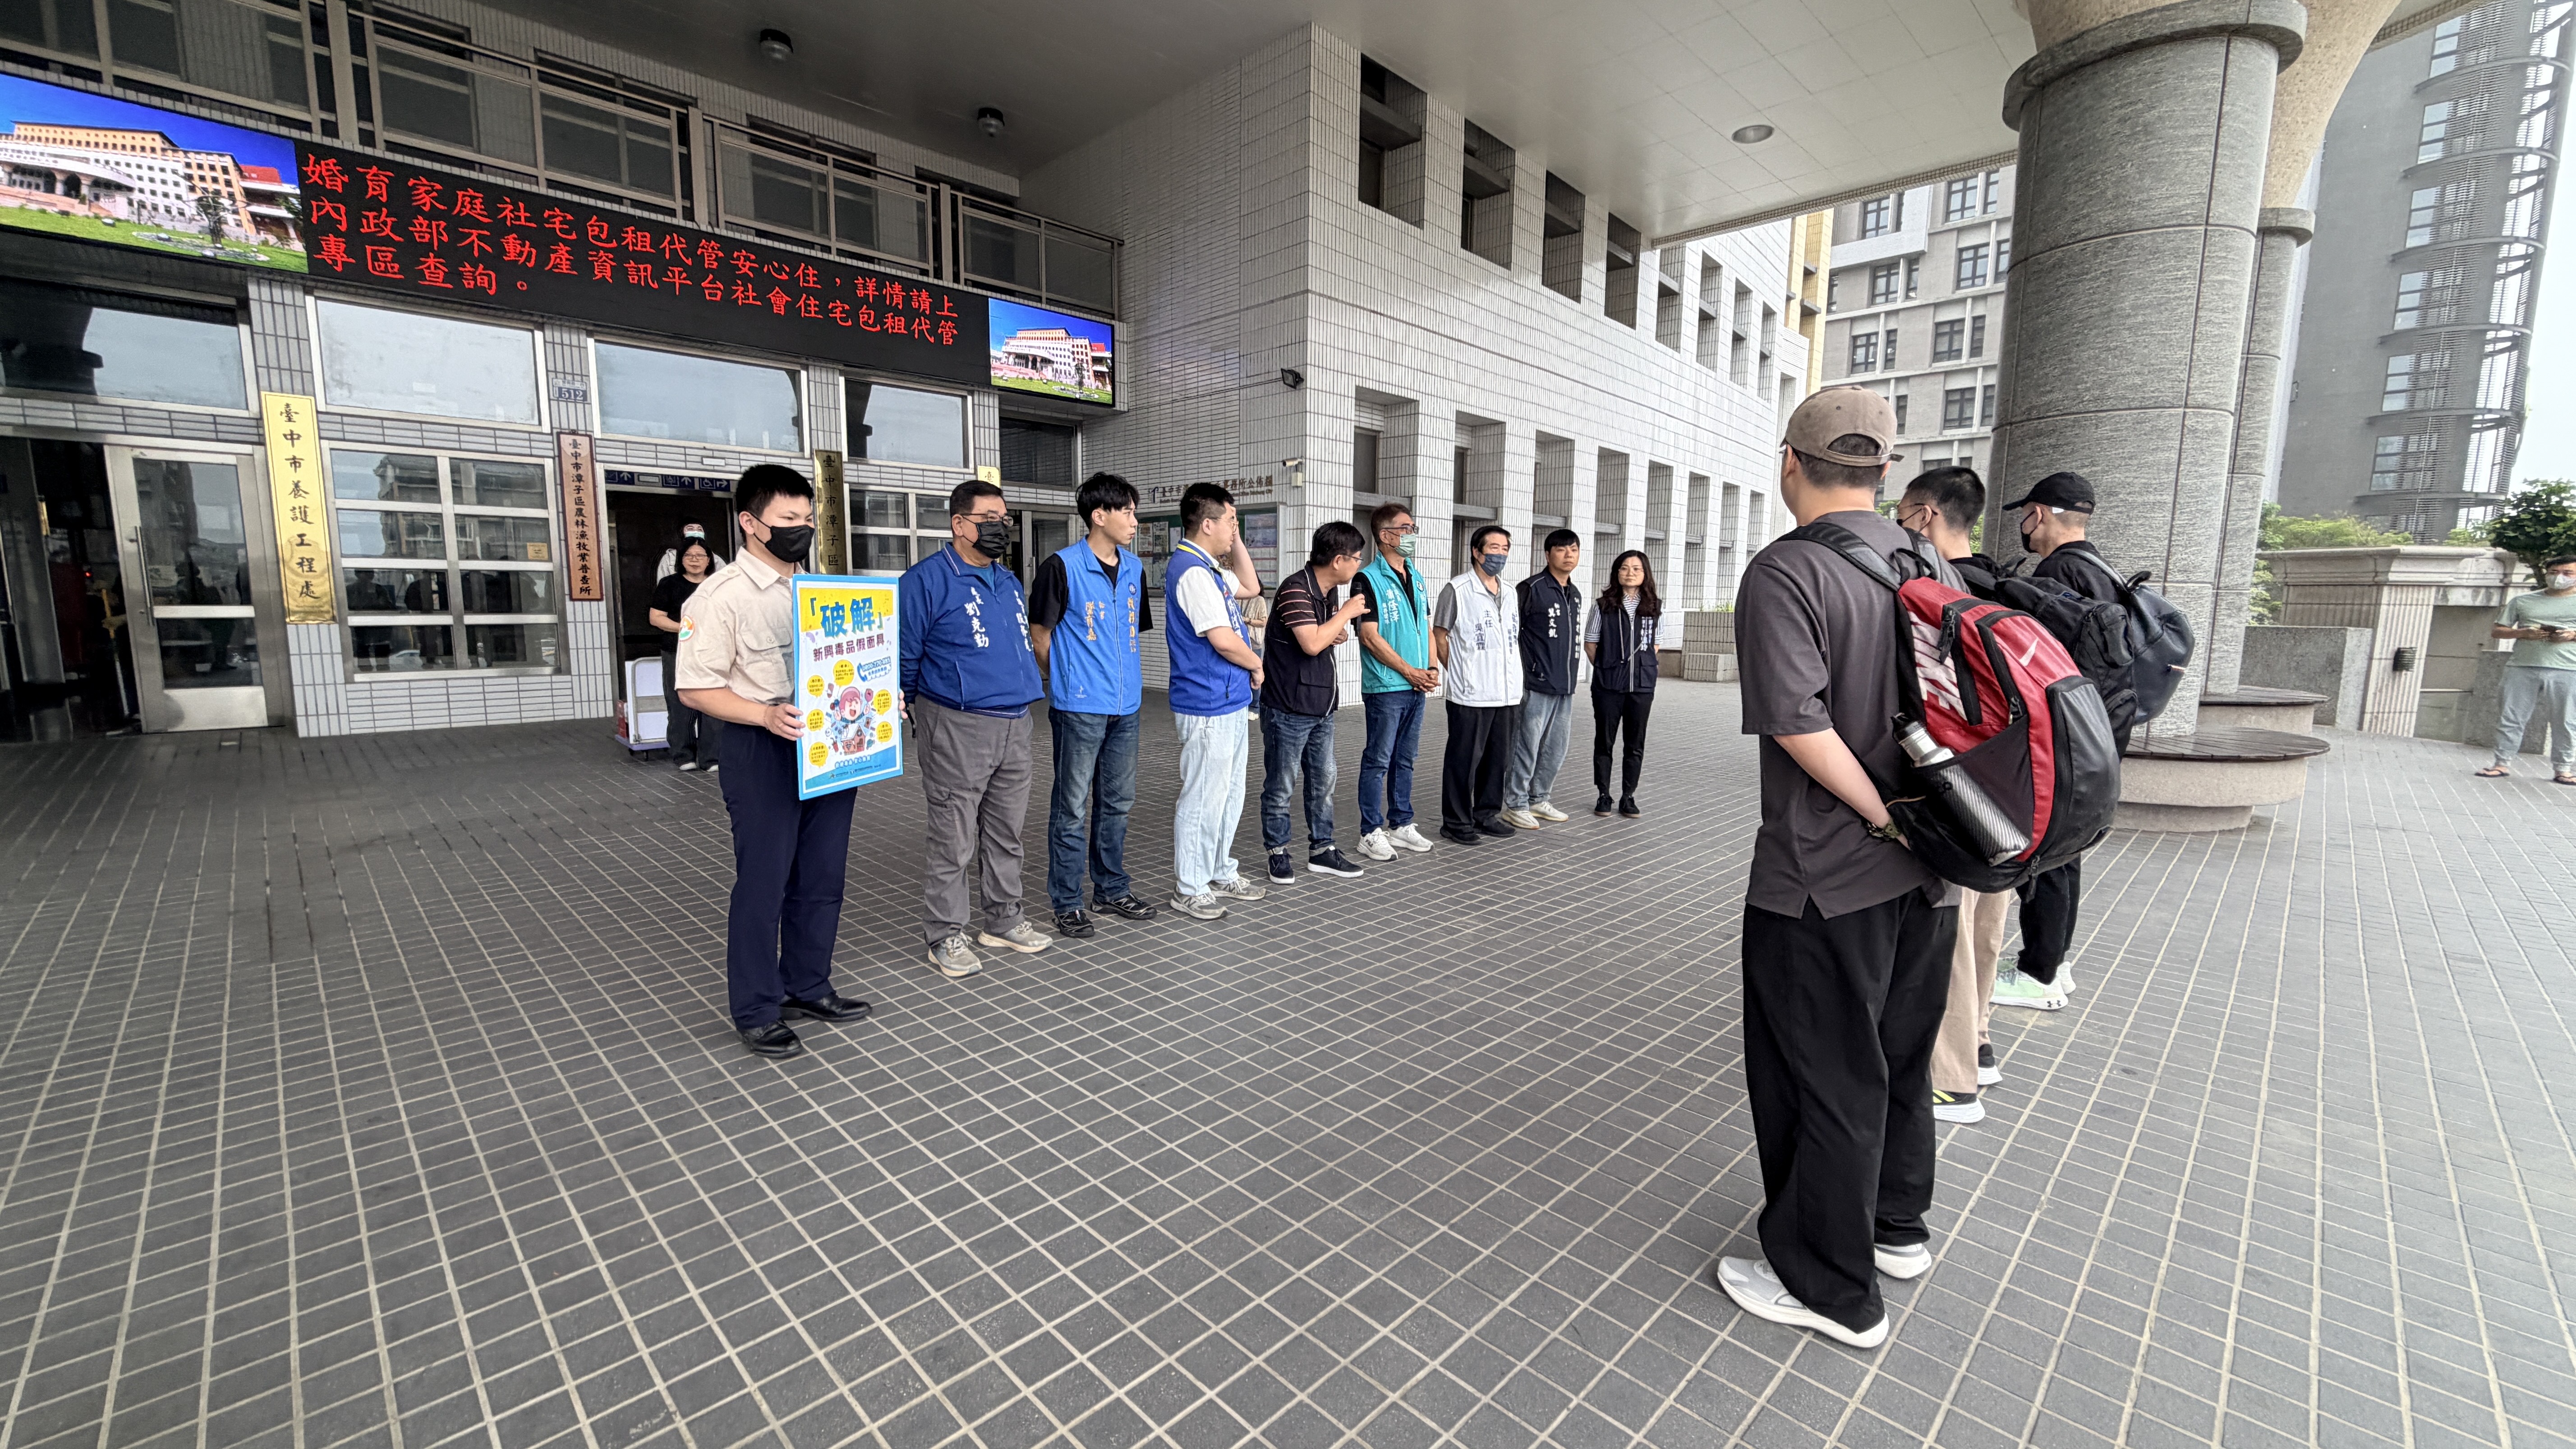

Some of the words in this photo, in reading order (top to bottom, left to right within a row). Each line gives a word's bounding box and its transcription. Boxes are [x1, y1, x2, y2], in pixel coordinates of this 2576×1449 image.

[302, 153, 958, 318] 婚育家庭社宅包租代管安心住，詳情請上
[310, 197, 959, 345] 內政部不動產資訊平台社會住宅包租代管
[313, 234, 528, 295] 專區查詢。
[562, 388, 583, 400] 512
[280, 403, 321, 599] 臺中市養護工程處
[823, 455, 839, 566] 臺中市潭子區
[810, 596, 883, 639] 「破解」
[964, 602, 989, 647] 劉克勤
[1484, 610, 1493, 628] 主任
[813, 633, 884, 662] 新興毒品假面具
